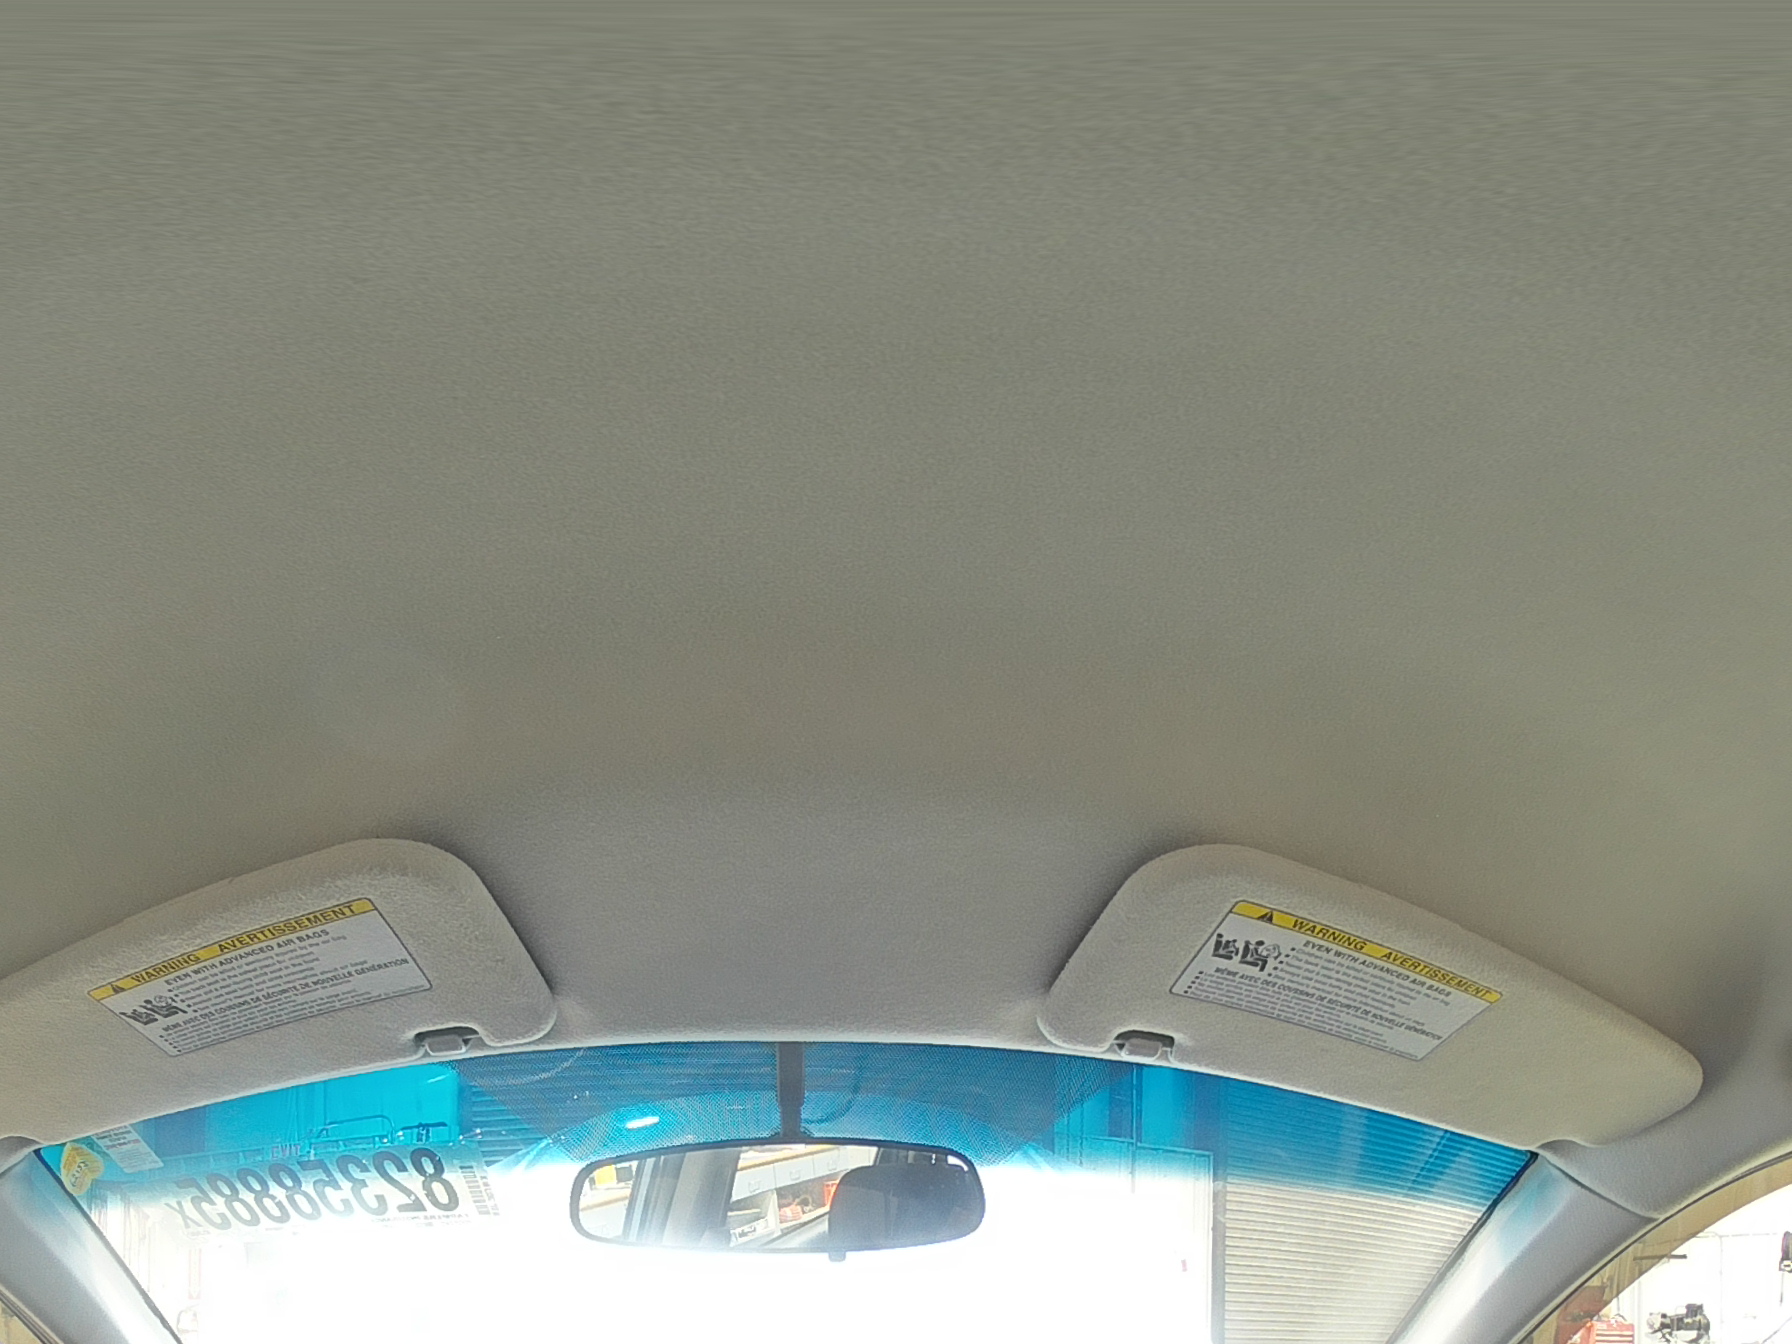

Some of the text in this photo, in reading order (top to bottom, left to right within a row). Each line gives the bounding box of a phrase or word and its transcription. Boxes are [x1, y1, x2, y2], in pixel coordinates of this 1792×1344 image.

[131, 953, 201, 983] WARNING
[218, 904, 356, 953] AVERTISSEMENT
[219, 944, 275, 967] ADVANCED
[298, 929, 330, 944] BAGS
[1292, 919, 1367, 951] WARNING
[1381, 951, 1492, 999] AVERTISSEMENT
[1303, 940, 1332, 955] EVEN
[1333, 949, 1359, 962] WITH
[1360, 959, 1409, 982] ADVANCED
